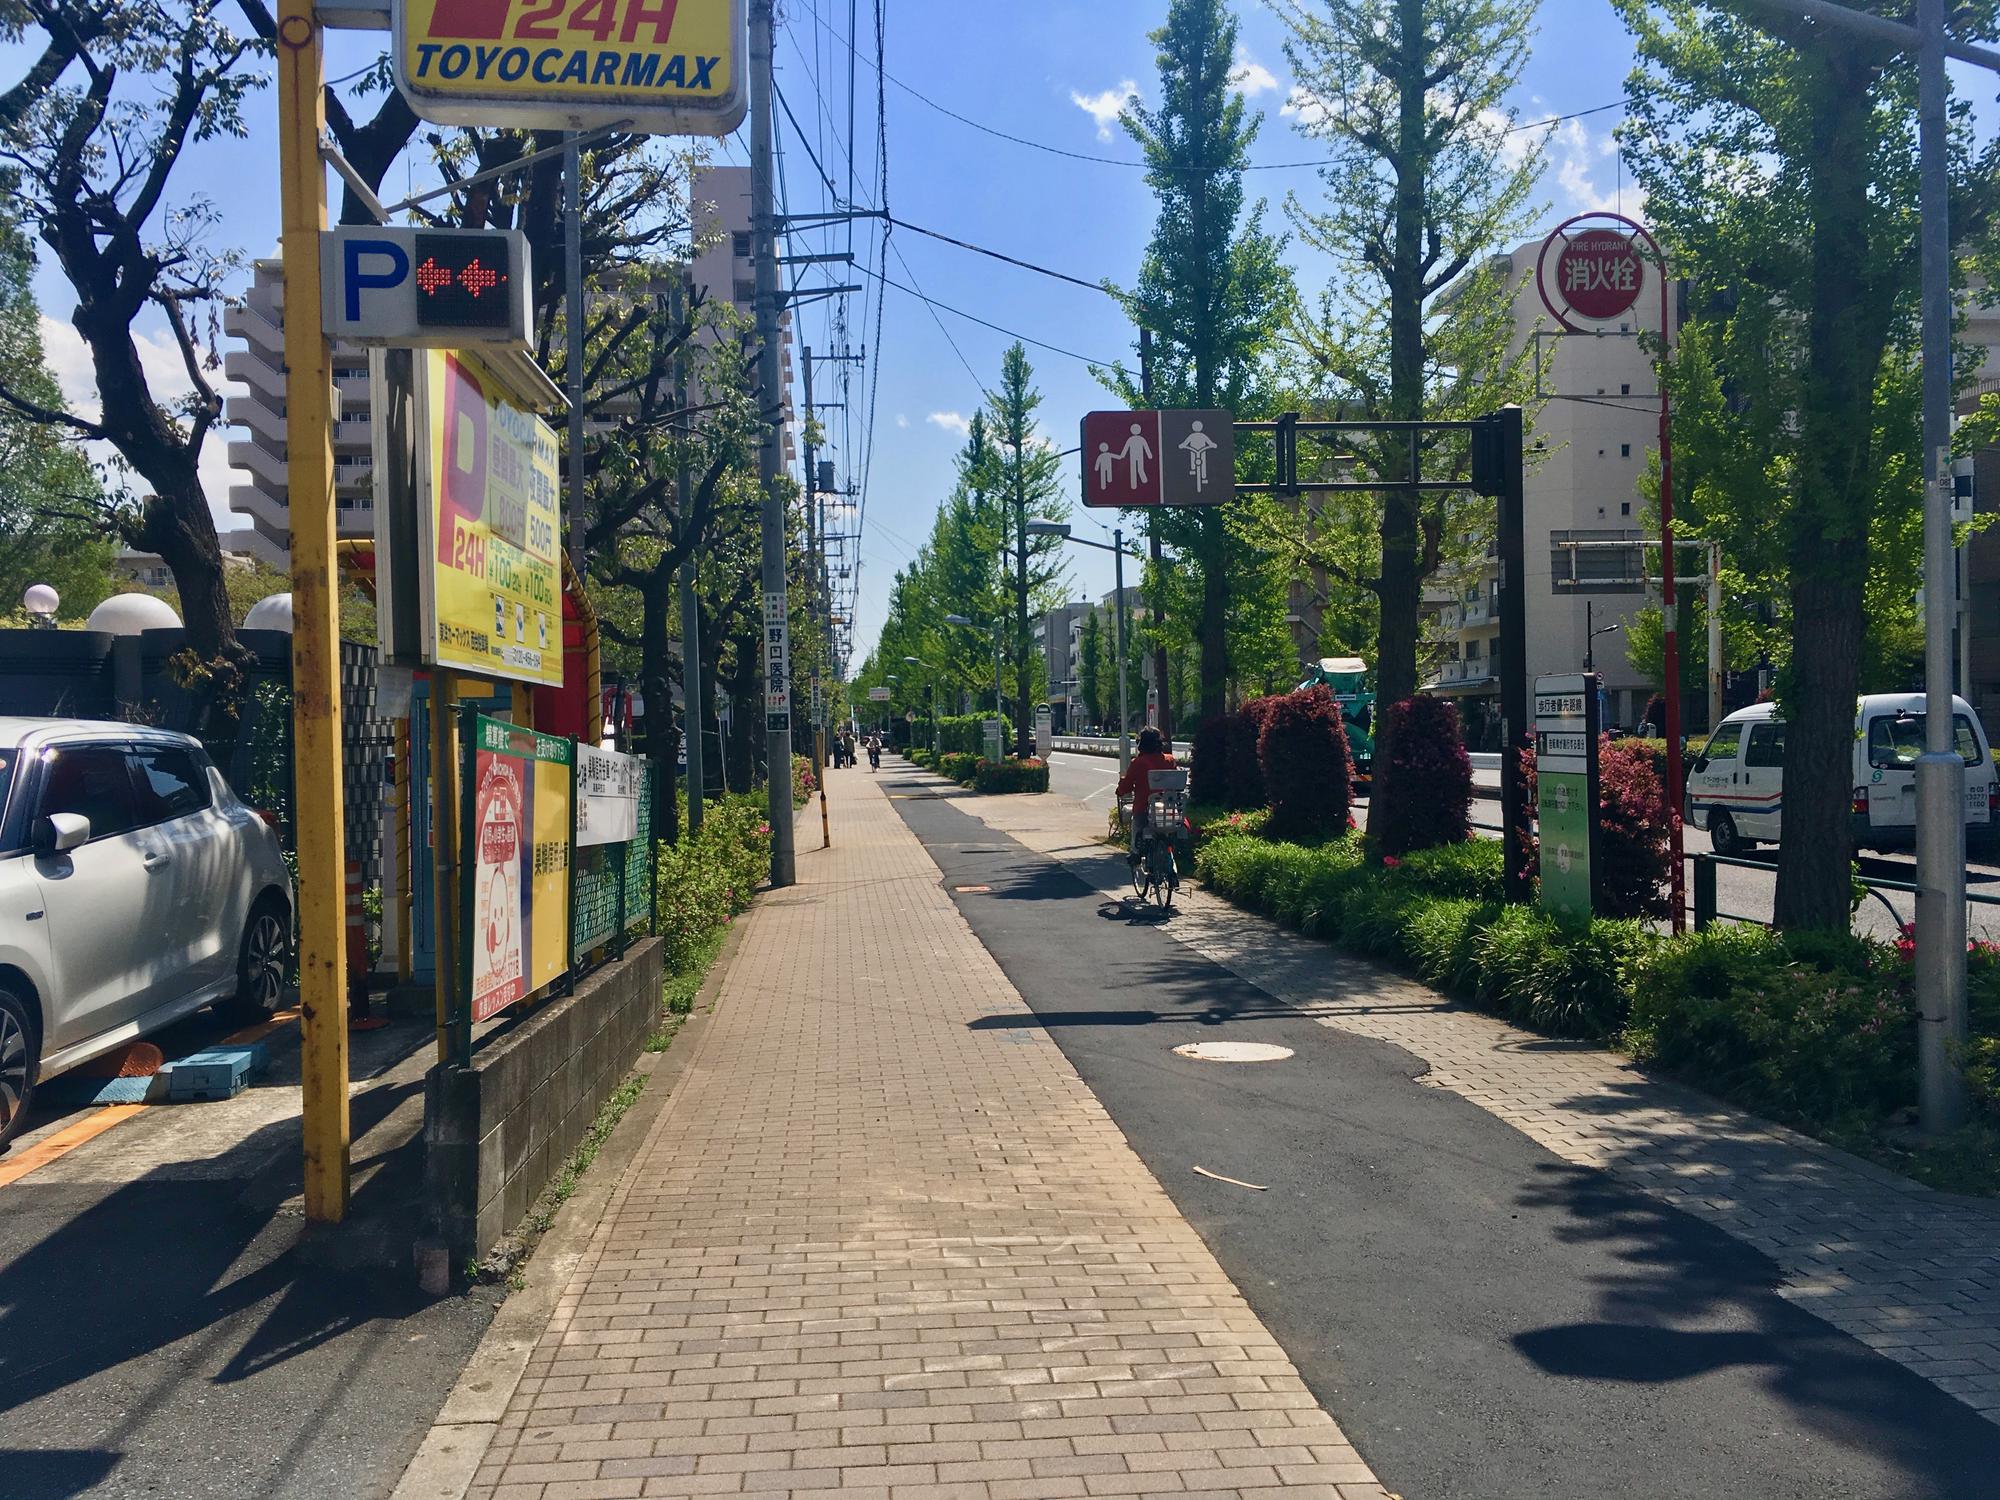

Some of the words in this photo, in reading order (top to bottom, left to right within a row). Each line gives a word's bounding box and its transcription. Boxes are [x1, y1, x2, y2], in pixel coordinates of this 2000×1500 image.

[514, 0, 678, 44] 24H
[416, 43, 722, 91] TOYOCARMAX
[1570, 241, 1588, 251] FIRE
[1591, 241, 1629, 252] HYDRANT
[344, 239, 410, 322] P
[1565, 256, 1637, 291] 消火栓
[454, 526, 486, 580] 24H
[530, 514, 552, 557] 500円
[768, 628, 784, 694] 野口医院
